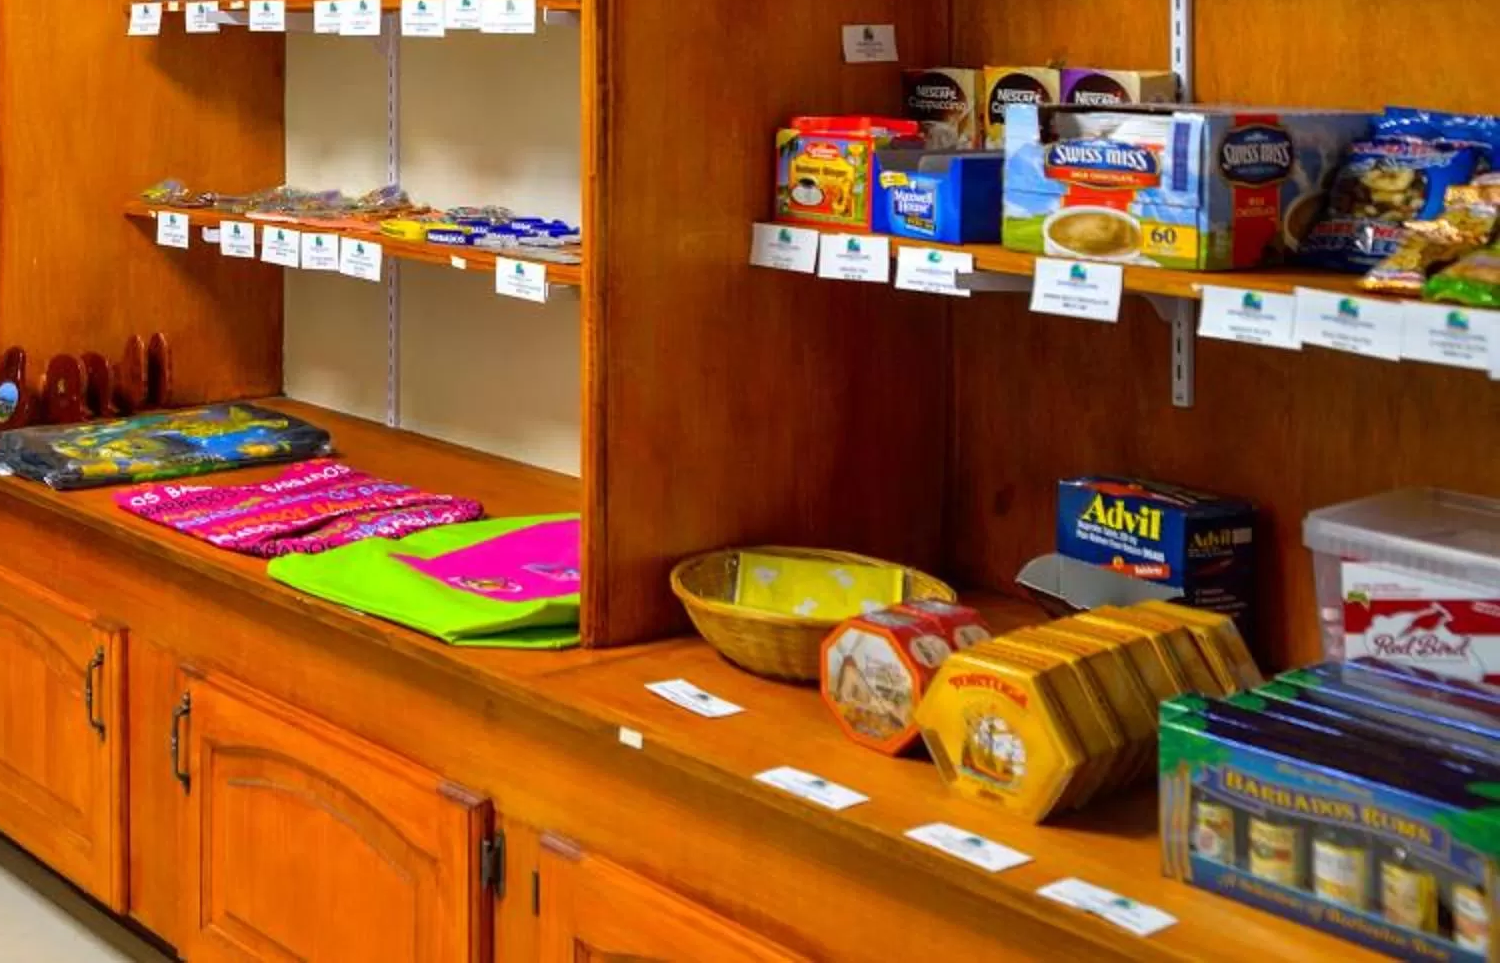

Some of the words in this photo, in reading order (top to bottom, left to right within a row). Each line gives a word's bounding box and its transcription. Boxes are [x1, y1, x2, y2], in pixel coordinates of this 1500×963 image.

[1150, 227, 1177, 245] 60
[1080, 492, 1163, 542] Advil
[1224, 769, 1356, 822] BARBADOS
